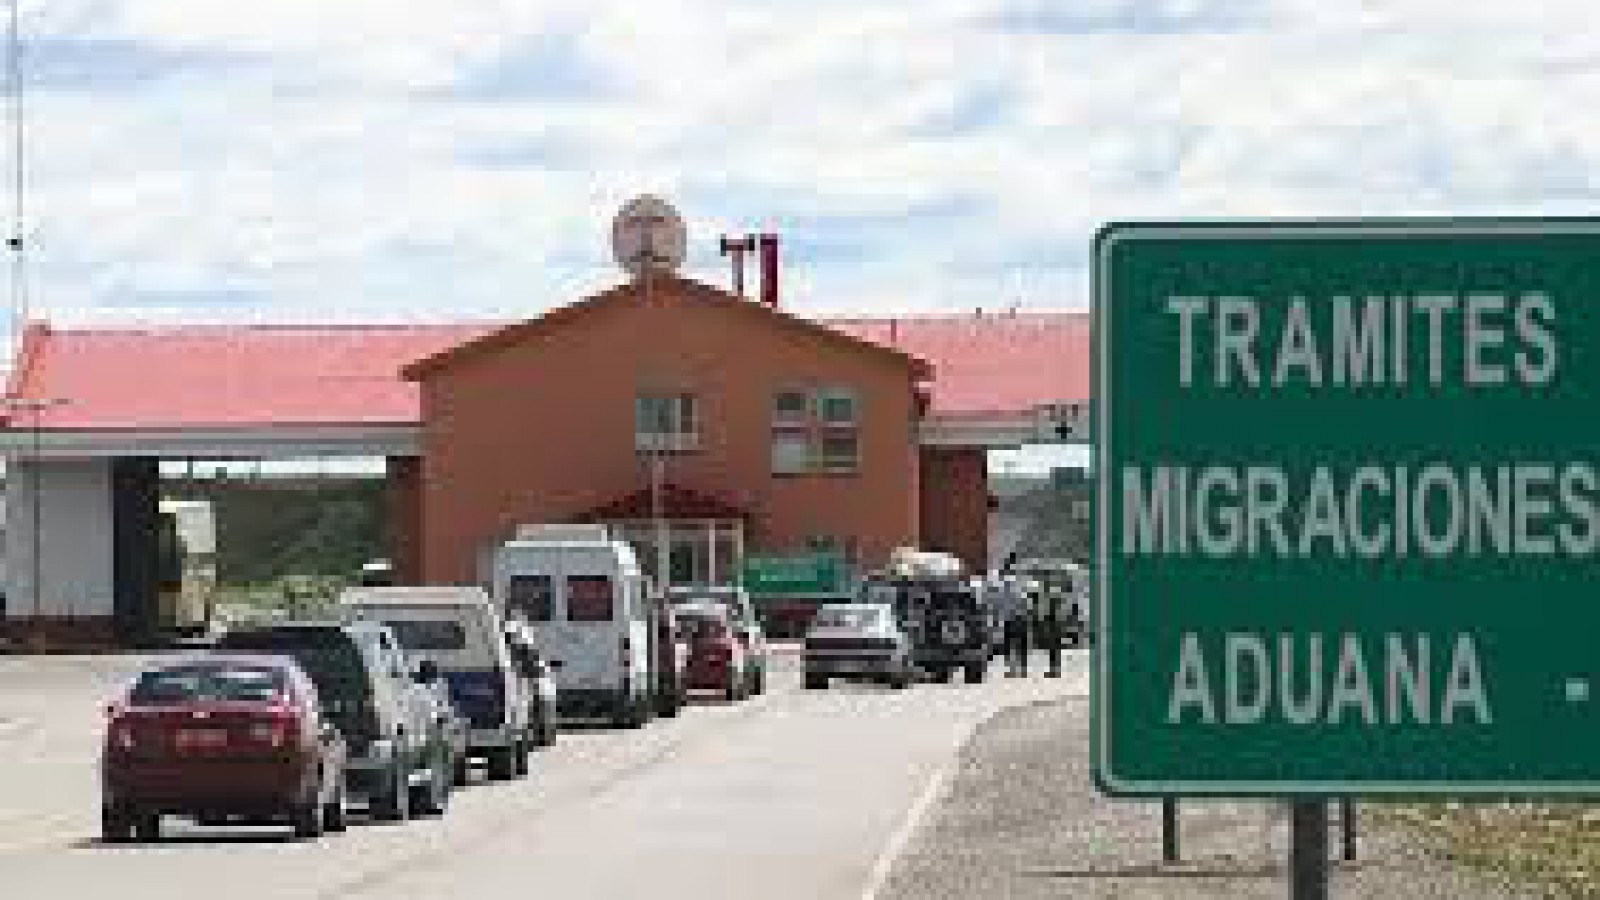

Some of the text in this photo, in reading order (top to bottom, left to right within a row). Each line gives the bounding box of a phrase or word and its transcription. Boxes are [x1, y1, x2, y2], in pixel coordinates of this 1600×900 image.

[1168, 292, 1557, 388] TRAMITES
[1122, 461, 1600, 558] MIGRACIONES
[1168, 631, 1493, 724] ADUANA
